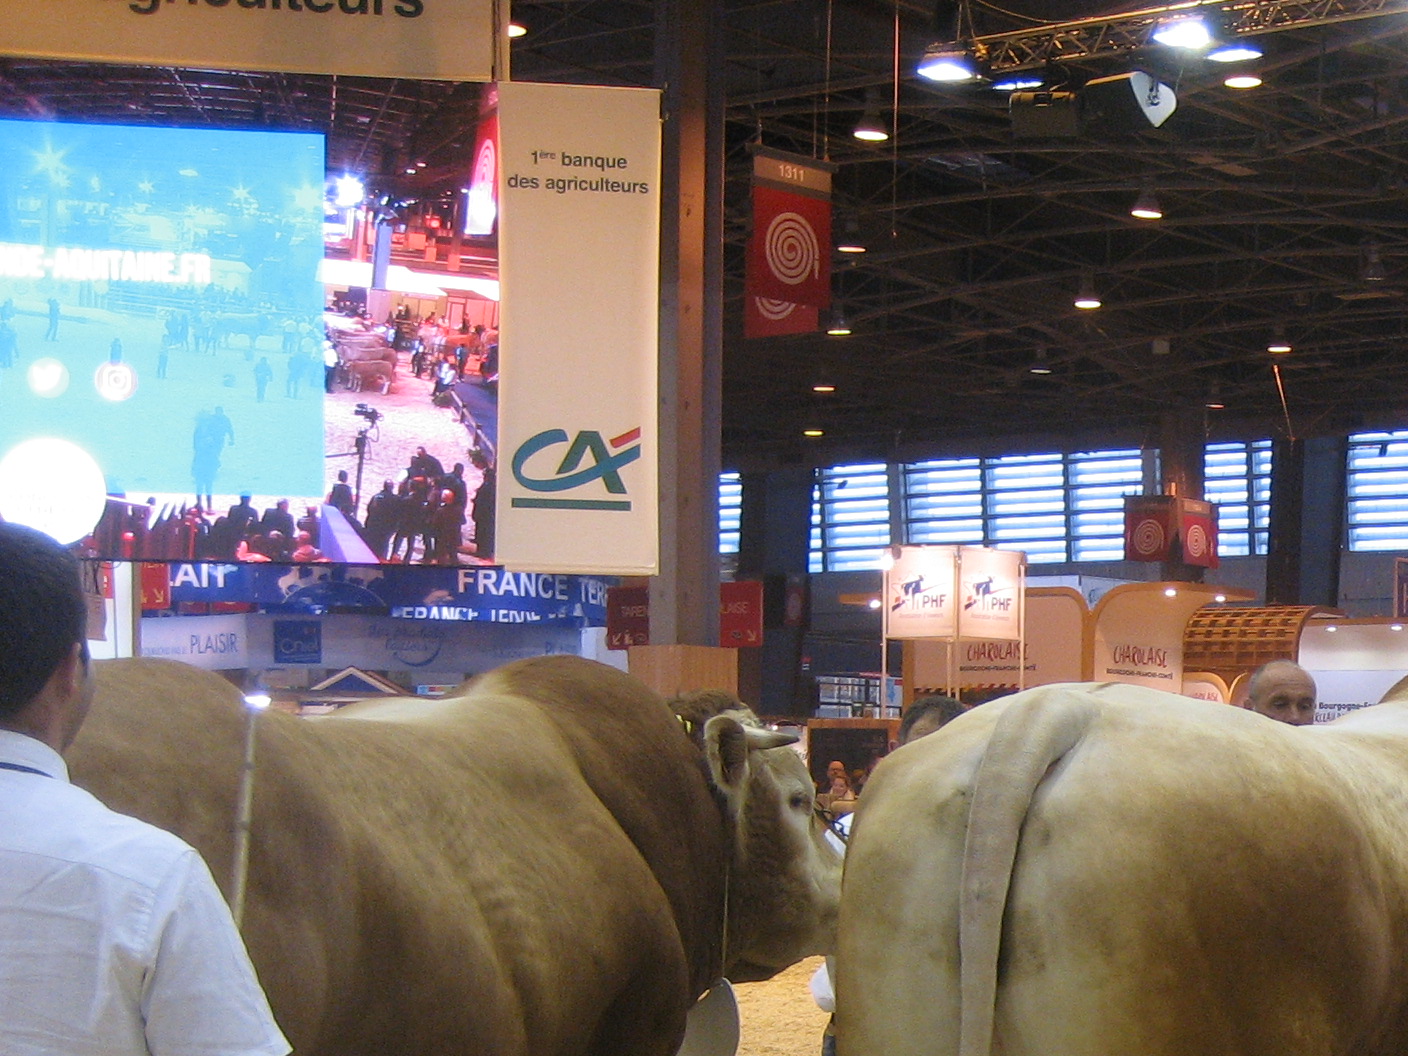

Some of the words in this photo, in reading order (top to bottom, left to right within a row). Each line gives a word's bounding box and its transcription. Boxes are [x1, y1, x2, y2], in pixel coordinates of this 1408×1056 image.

[561, 151, 628, 172] banque
[778, 164, 805, 182] 1311
[507, 174, 539, 189] des
[545, 175, 649, 194] agriculteurs
[456, 568, 569, 601] FRANCE
[922, 594, 947, 608] PHF
[991, 597, 1012, 611] PHF
[190, 633, 238, 654] PLAISIR
[1113, 645, 1168, 668] CHAROLAISE
